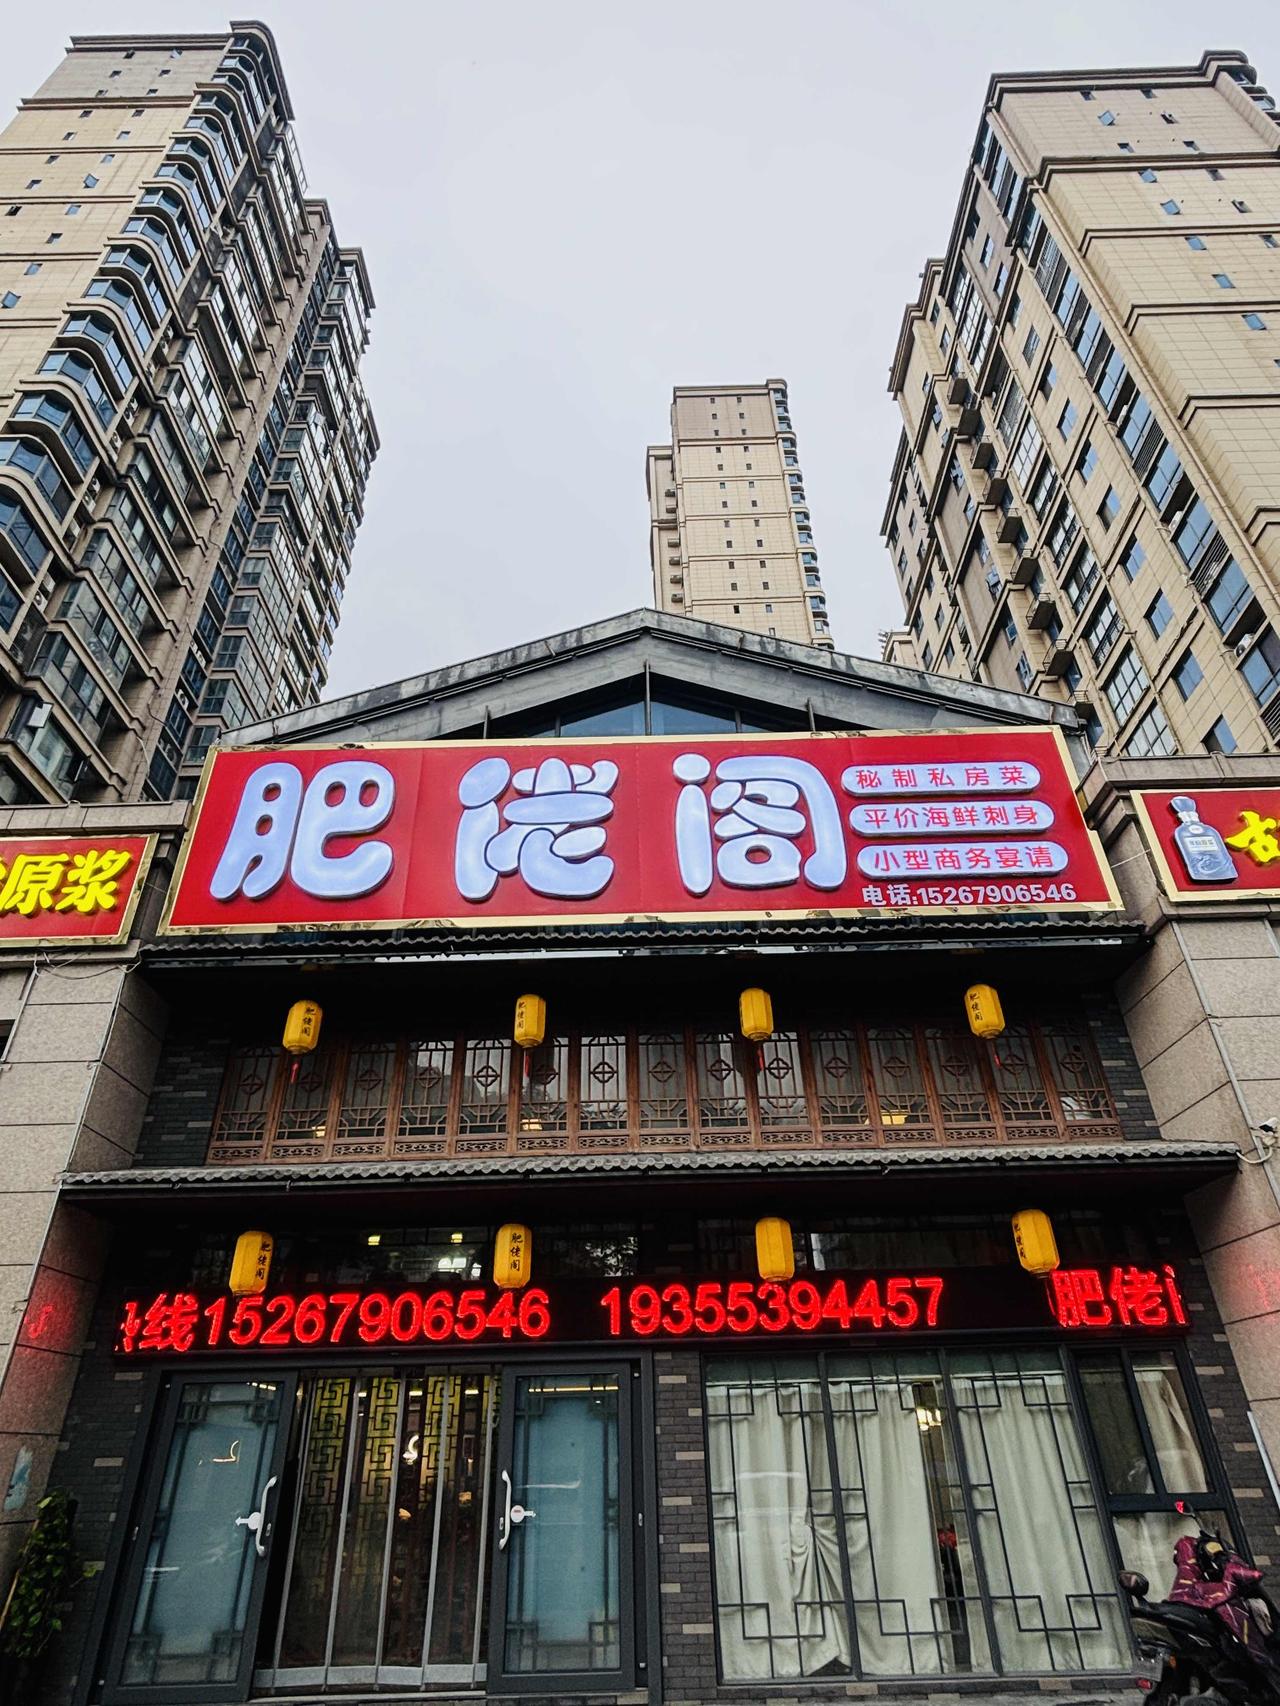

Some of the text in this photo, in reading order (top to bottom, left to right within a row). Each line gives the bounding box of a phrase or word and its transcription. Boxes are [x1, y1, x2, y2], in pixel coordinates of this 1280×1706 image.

[856, 765, 1028, 789] 秘制私房菜
[864, 804, 1038, 829] 平价海鲜刺身
[874, 845, 1054, 872] 小型商务宴请
[0, 849, 132, 915] 原浆
[861, 882, 1077, 906] 电话:15267906546
[600, 1277, 944, 1336] 19355394457
